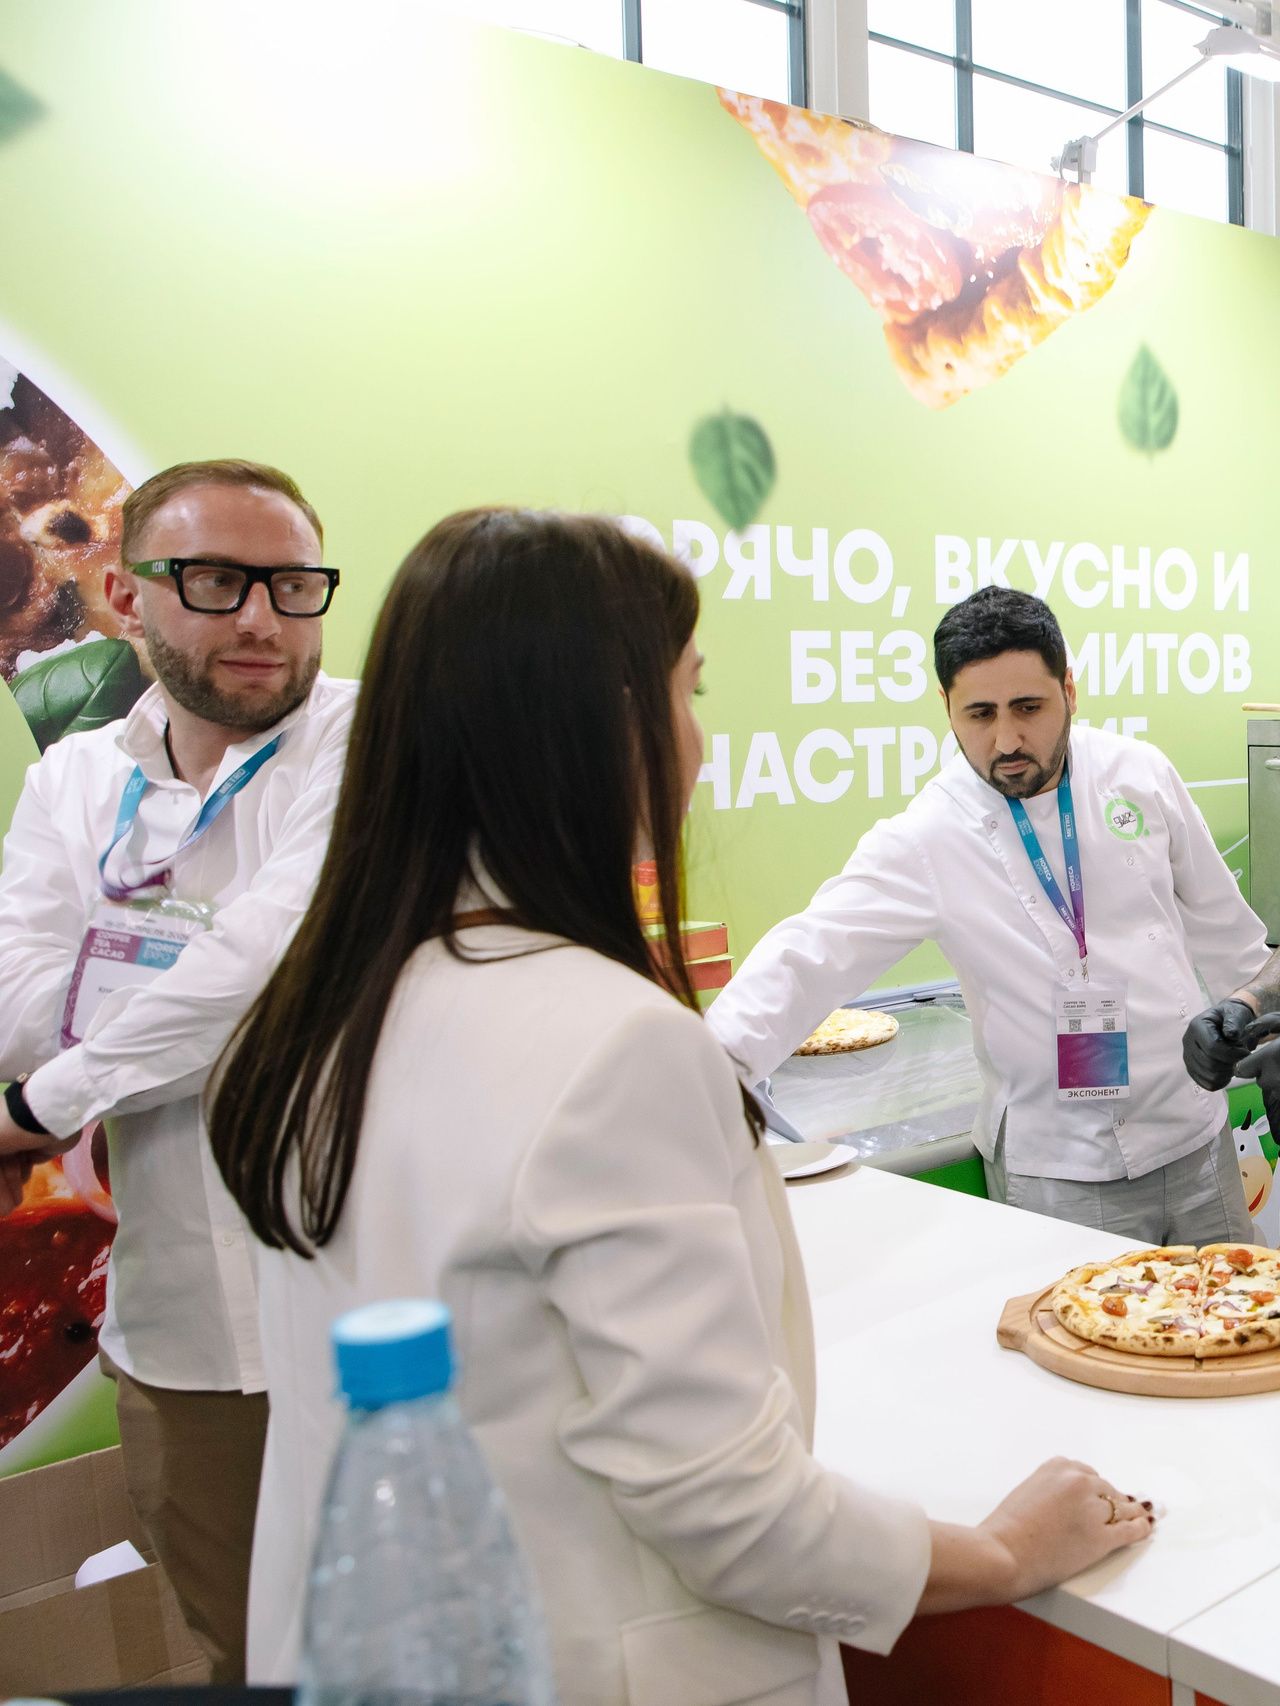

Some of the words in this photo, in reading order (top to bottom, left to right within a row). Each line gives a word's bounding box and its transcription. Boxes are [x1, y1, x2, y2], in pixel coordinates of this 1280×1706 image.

[616, 516, 912, 618] РЯЧО,
[935, 534, 1198, 611] ВКУСНО
[1213, 551, 1249, 612] И
[790, 629, 929, 705] БЕЗ
[1063, 632, 1253, 696] МИТОВ
[219, 768, 246, 795] METRO
[1064, 813, 1072, 838] METRO
[1038, 857, 1053, 882] HORECA
[1068, 865, 1076, 891] HORECA
[1067, 1088, 1120, 1098] ЭКСПОНЕНТ
